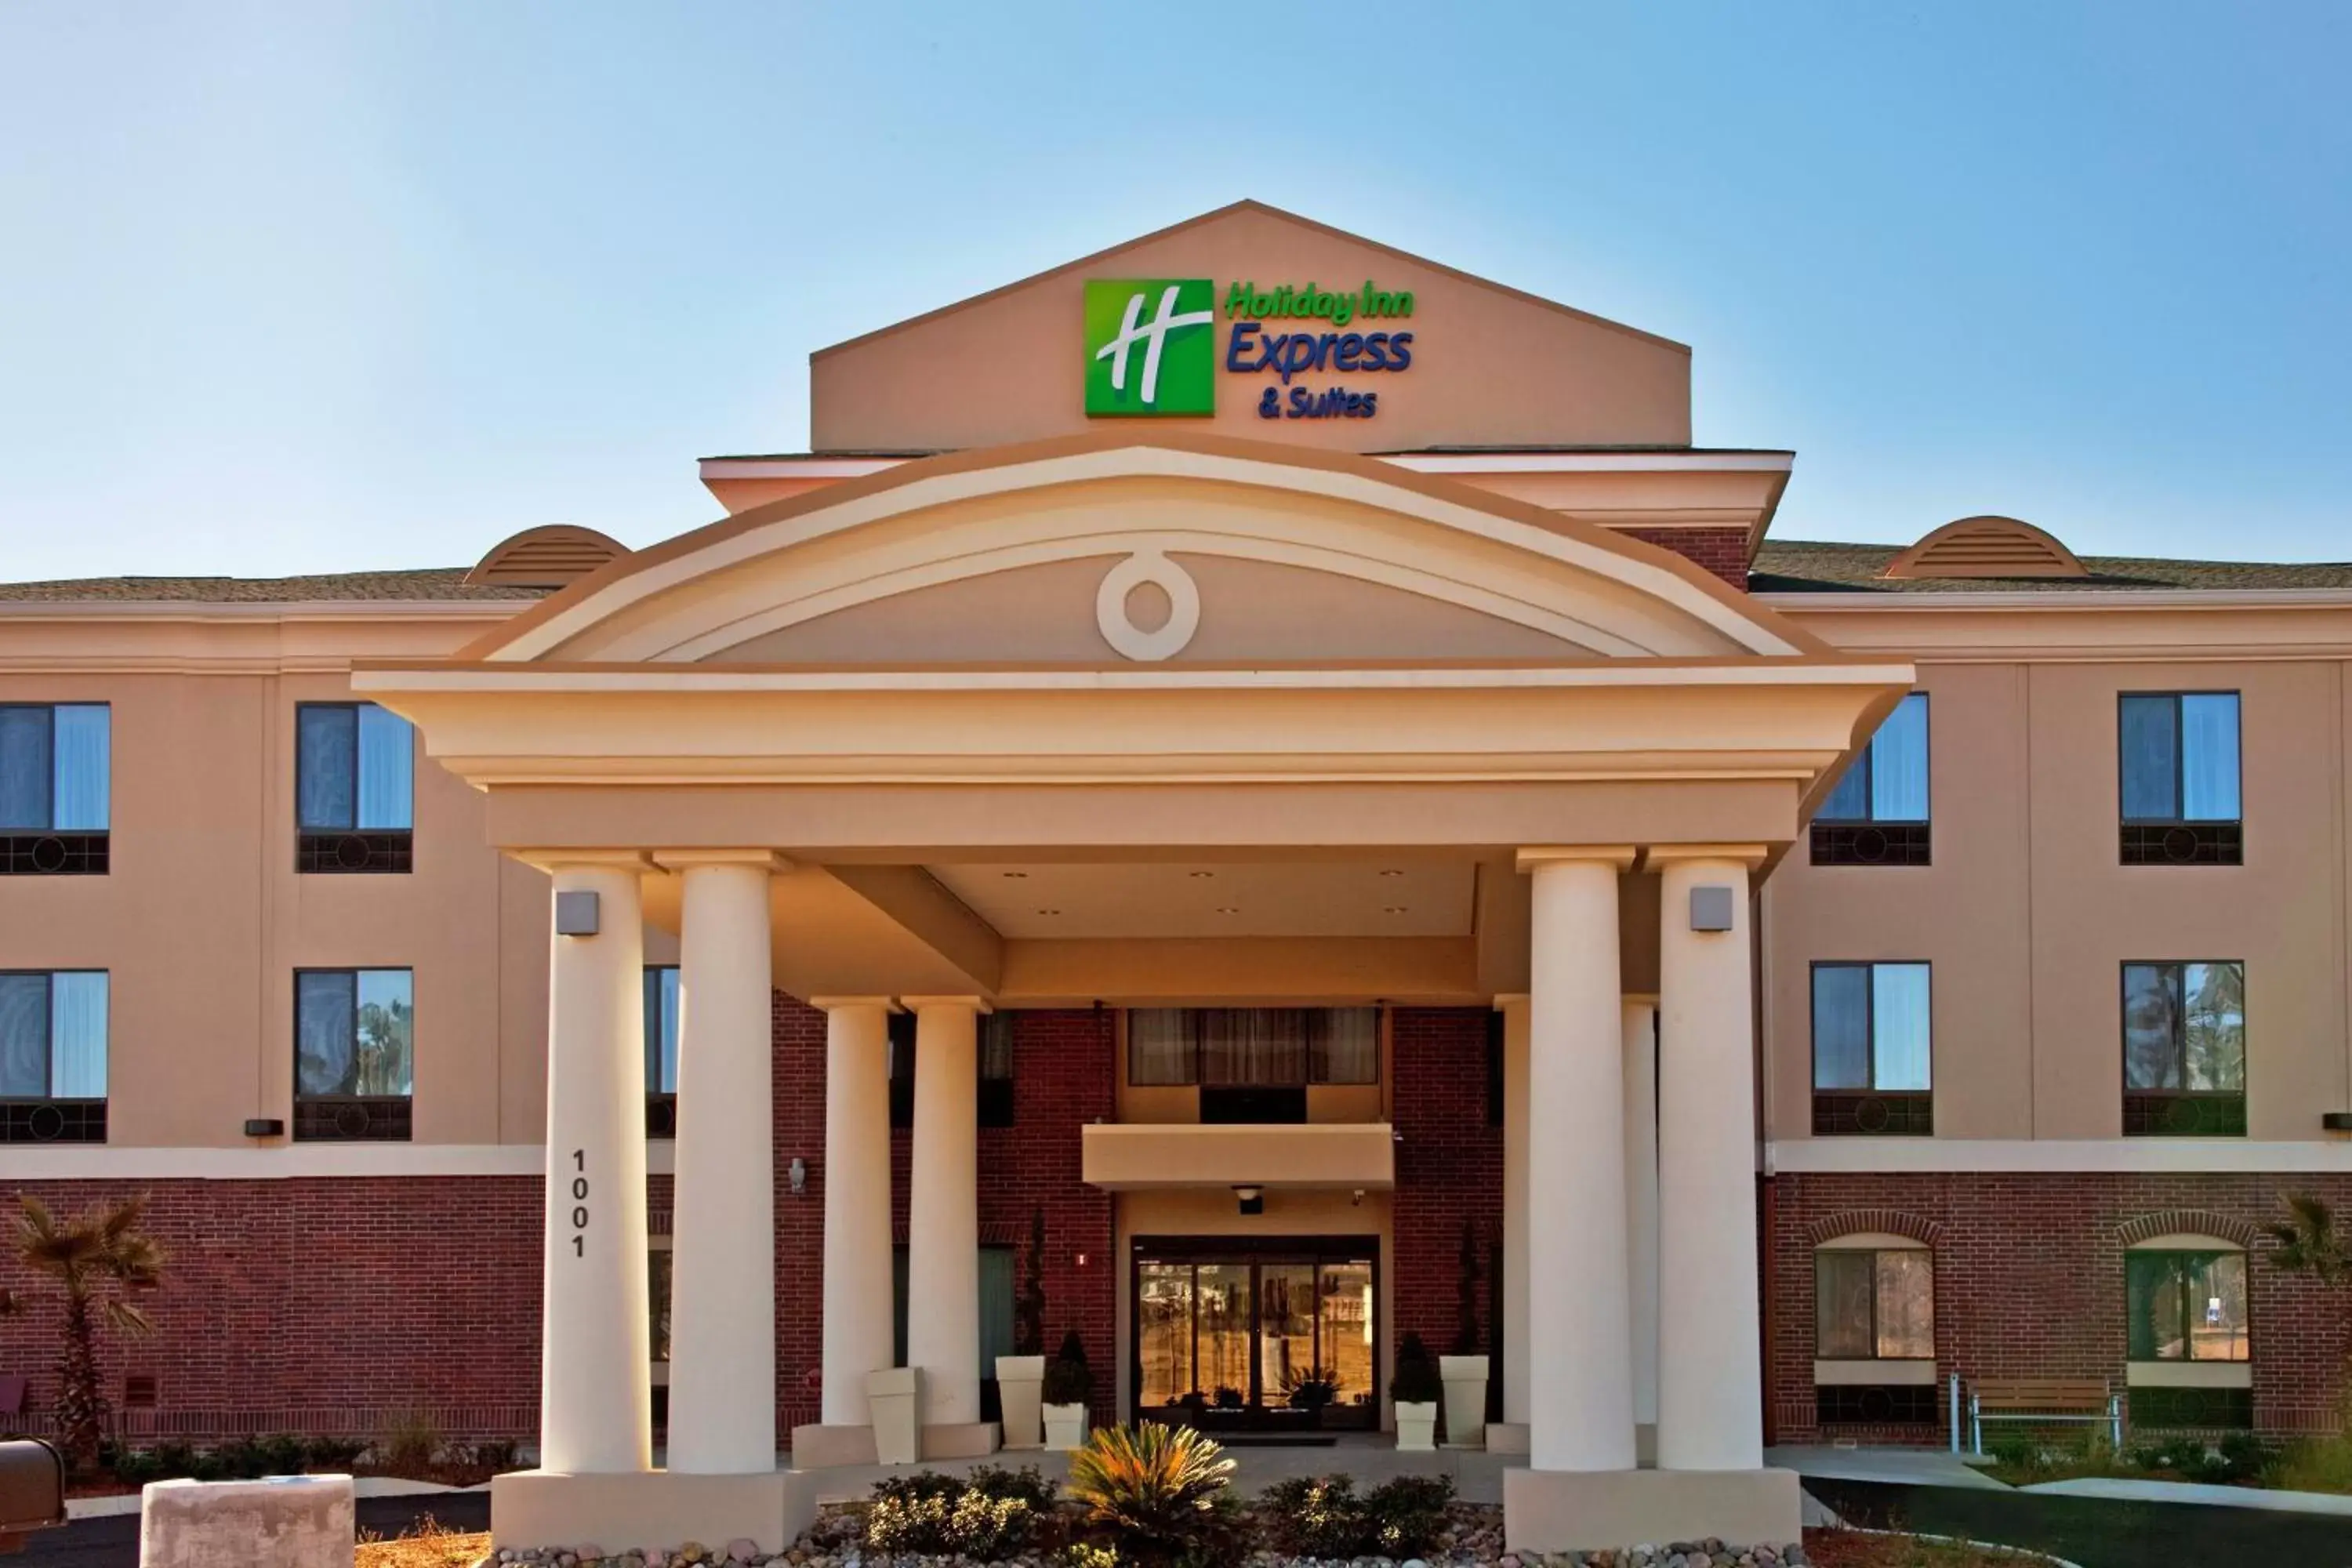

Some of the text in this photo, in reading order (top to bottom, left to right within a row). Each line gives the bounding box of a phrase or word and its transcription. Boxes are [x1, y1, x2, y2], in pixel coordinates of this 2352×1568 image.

[1225, 280, 1414, 326] Holiday Inn
[1096, 285, 1213, 403] H
[1226, 322, 1414, 384] Express
[1258, 387, 1377, 419] & Suites
[572, 1149, 588, 1258] 1001
